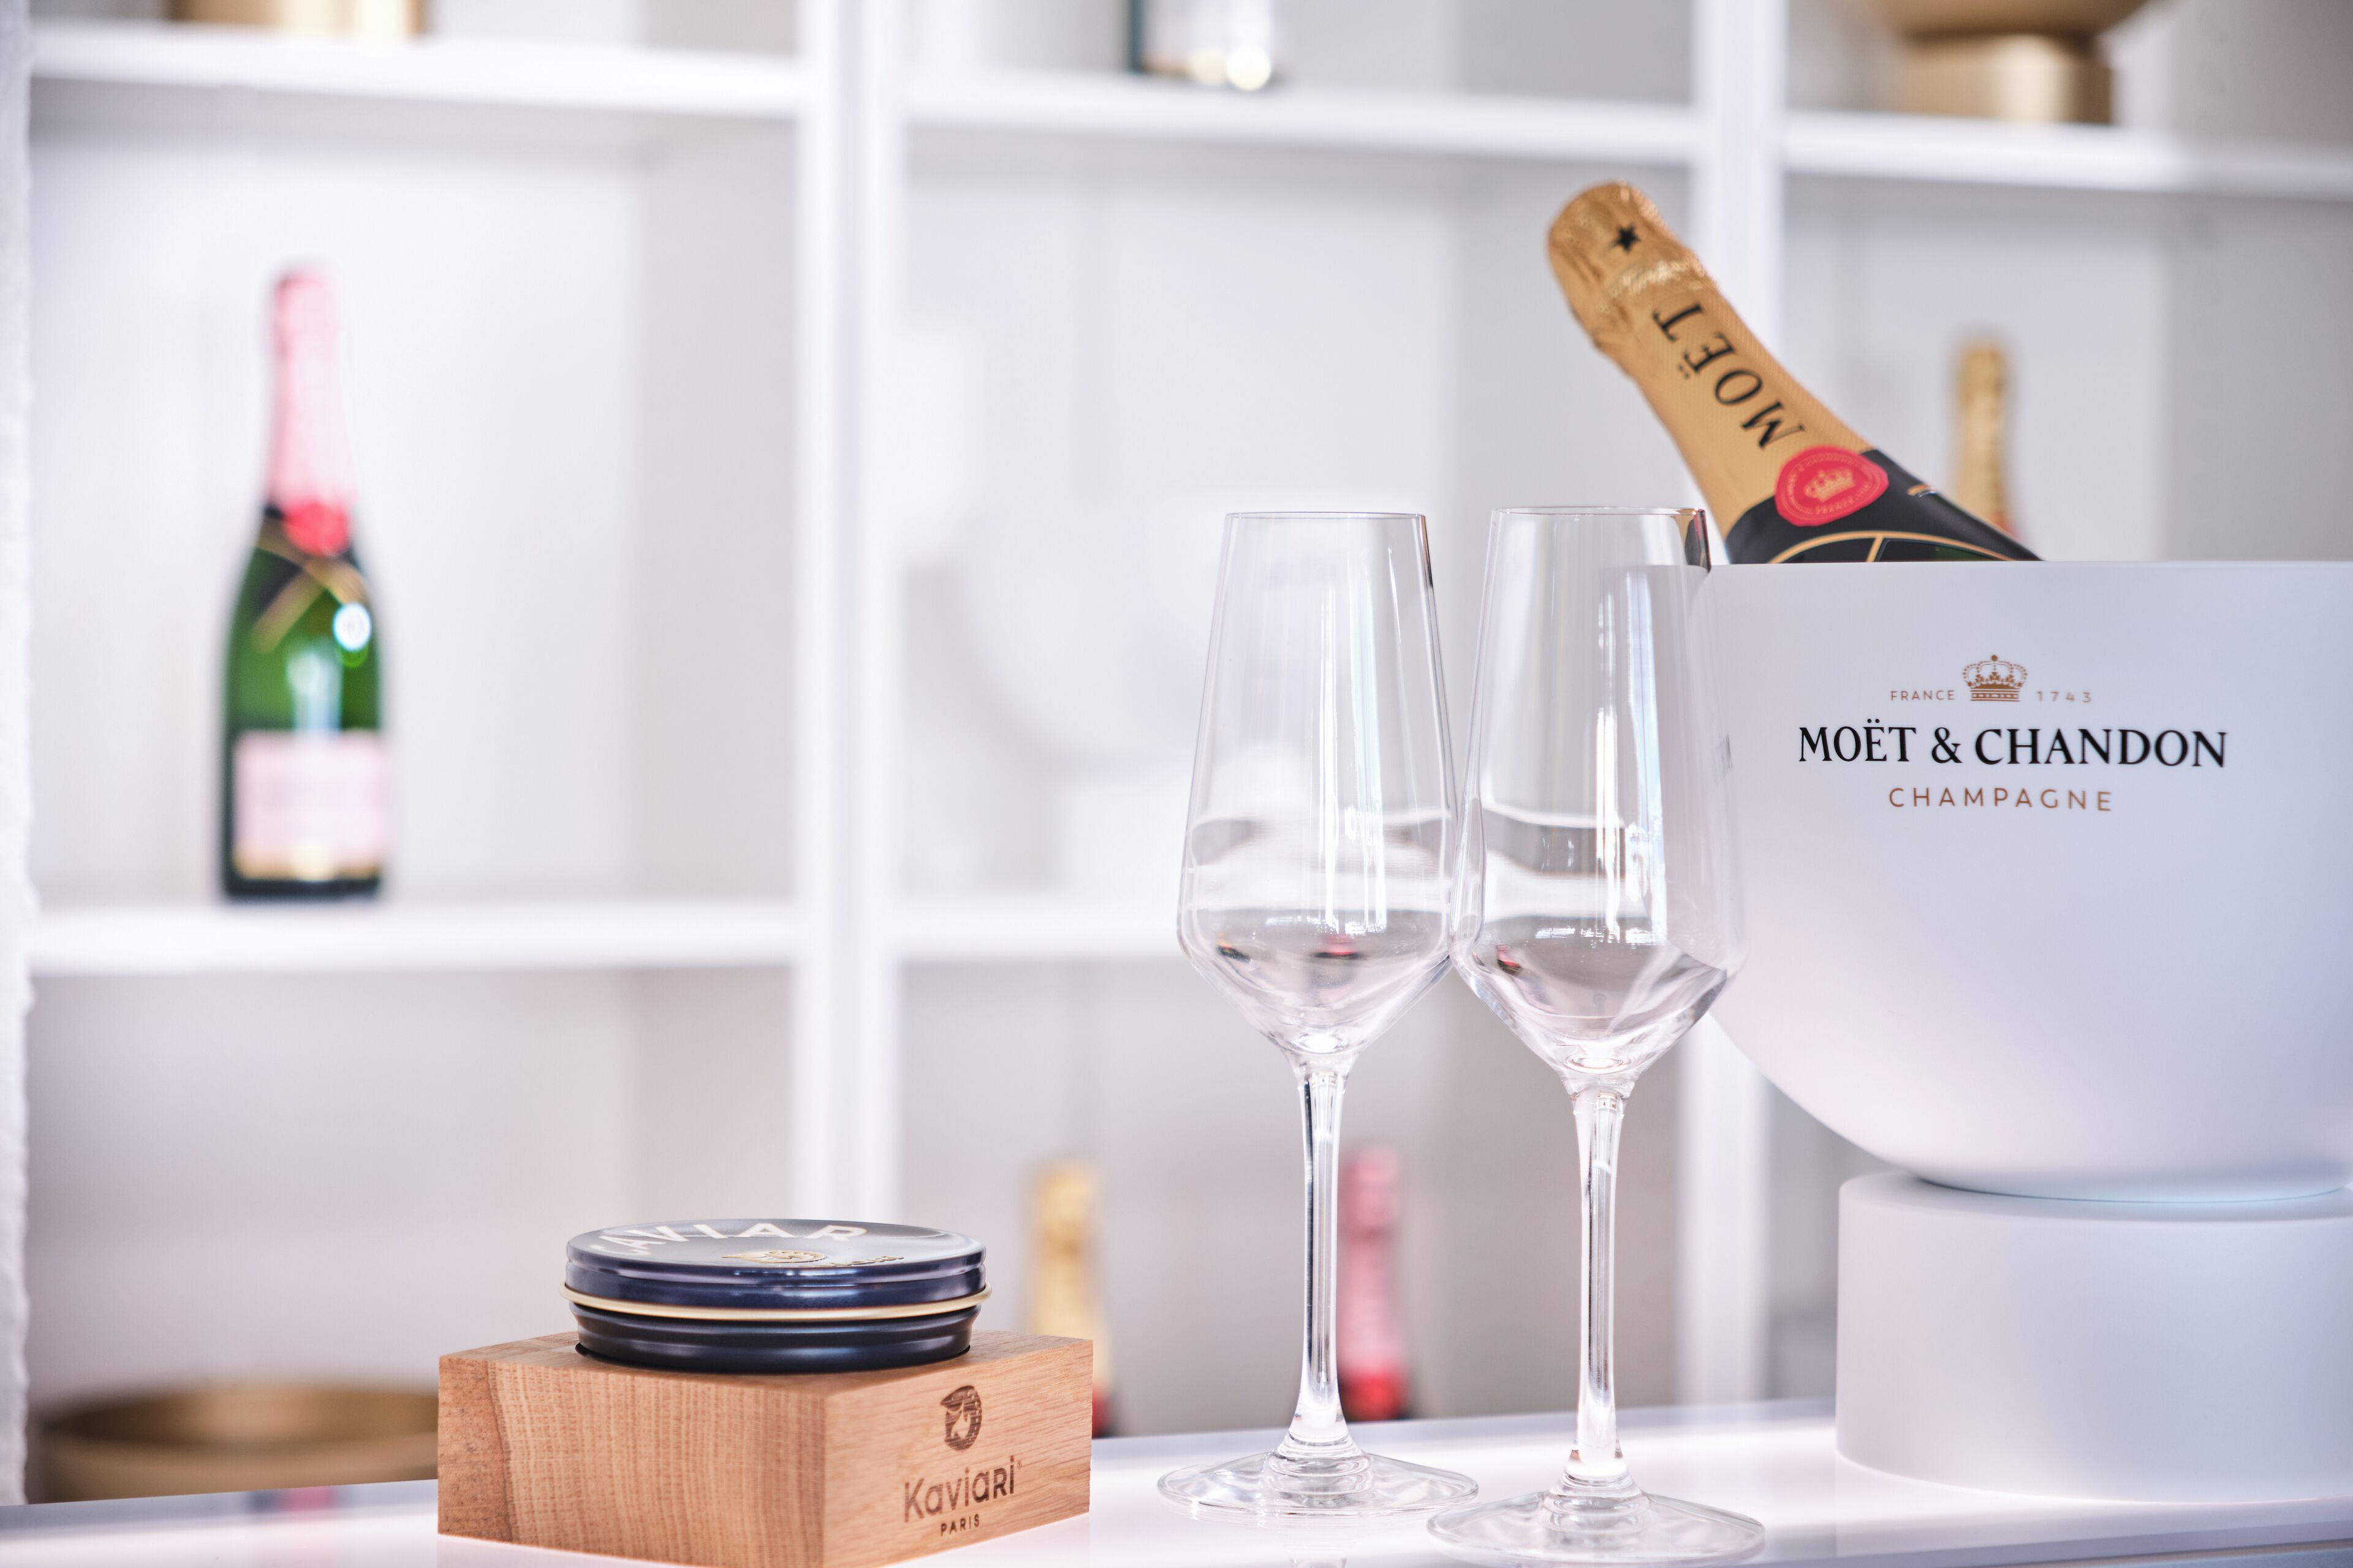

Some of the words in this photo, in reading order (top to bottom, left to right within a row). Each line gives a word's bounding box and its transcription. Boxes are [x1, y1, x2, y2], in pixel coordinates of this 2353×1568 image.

[1652, 303, 1806, 450] MOËT
[1890, 690, 1956, 701] FRANCE
[1798, 718, 1917, 763] MOËT
[1931, 726, 1963, 764] &
[1974, 727, 2227, 768] CHANDON
[1889, 787, 2112, 812] CHAMPAGNE
[589, 1222, 868, 1256] CAVIAR
[941, 1513, 980, 1537] PARIS
